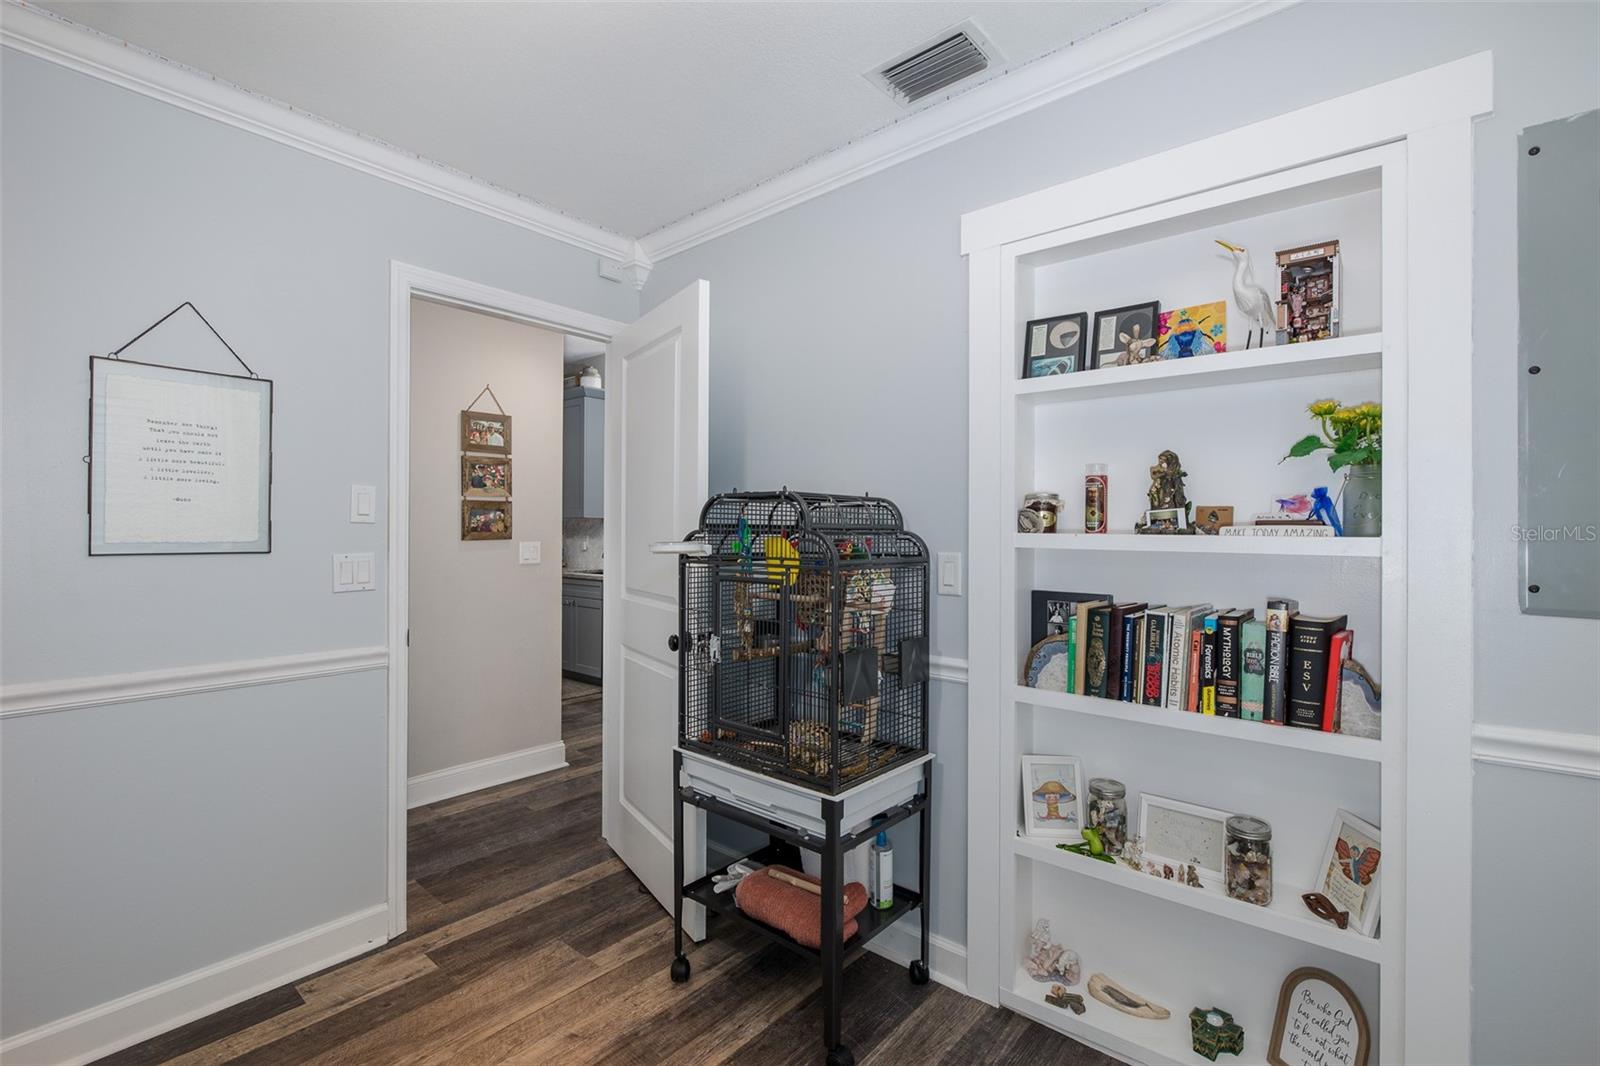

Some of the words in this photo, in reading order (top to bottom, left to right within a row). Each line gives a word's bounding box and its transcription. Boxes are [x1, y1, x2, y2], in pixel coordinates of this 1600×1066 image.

[1224, 528, 1247, 537] MAKE
[1253, 528, 1280, 537] TODAY
[1283, 528, 1329, 537] AMAZING
[1172, 631, 1183, 665] Atomic
[1204, 644, 1214, 679] Forensics
[1222, 627, 1232, 679] MYTHOLOGY
[1270, 636, 1280, 665] ACTION
[1169, 667, 1180, 697] Habits
[1268, 665, 1279, 683] BIBLE
[1297, 1003, 1309, 1020] has
[1311, 1017, 1337, 1038] called
[1333, 1033, 1350, 1048] you
[1301, 989, 1316, 1006] Be
[1317, 1002, 1332, 1017] who
[1333, 1009, 1353, 1031] God
[1288, 1031, 1302, 1048] the
[1292, 1016, 1301, 1030] to
[1315, 1036, 1331, 1050] not
[1328, 1046, 1353, 1065] what
